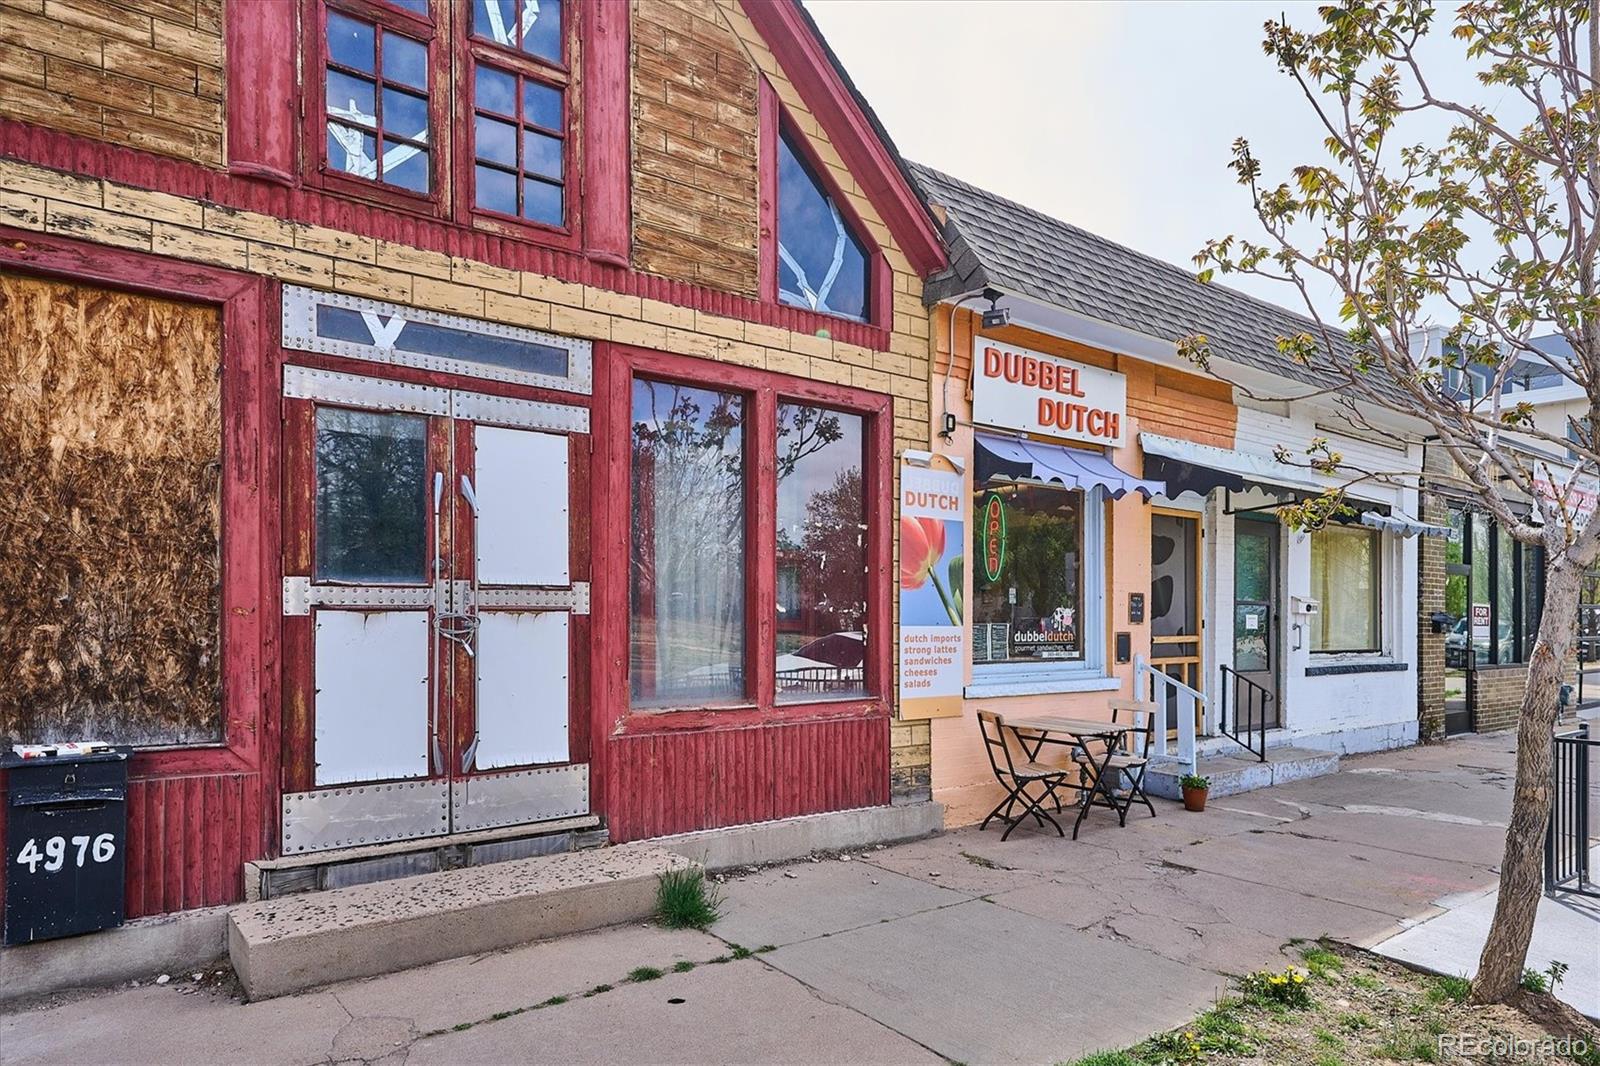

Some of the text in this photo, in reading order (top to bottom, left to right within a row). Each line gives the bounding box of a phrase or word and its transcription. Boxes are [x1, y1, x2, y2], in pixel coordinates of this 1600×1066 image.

[984, 347, 1085, 397] DUBBEL
[1038, 397, 1120, 439] DUTCH
[905, 491, 959, 511] DUTCH
[989, 501, 1000, 572] OPEN
[1475, 607, 1488, 616] FOR
[1474, 617, 1489, 625] RENT
[904, 634, 961, 644] dutch imports
[1014, 630, 1074, 642] dubbeldutch
[904, 646, 957, 655] strong lattes
[1015, 645, 1036, 653] gourmet
[904, 656, 952, 666] sandwiches
[904, 668, 938, 677] cheeses
[904, 679, 931, 689] salads
[16, 833, 117, 874] 4976
